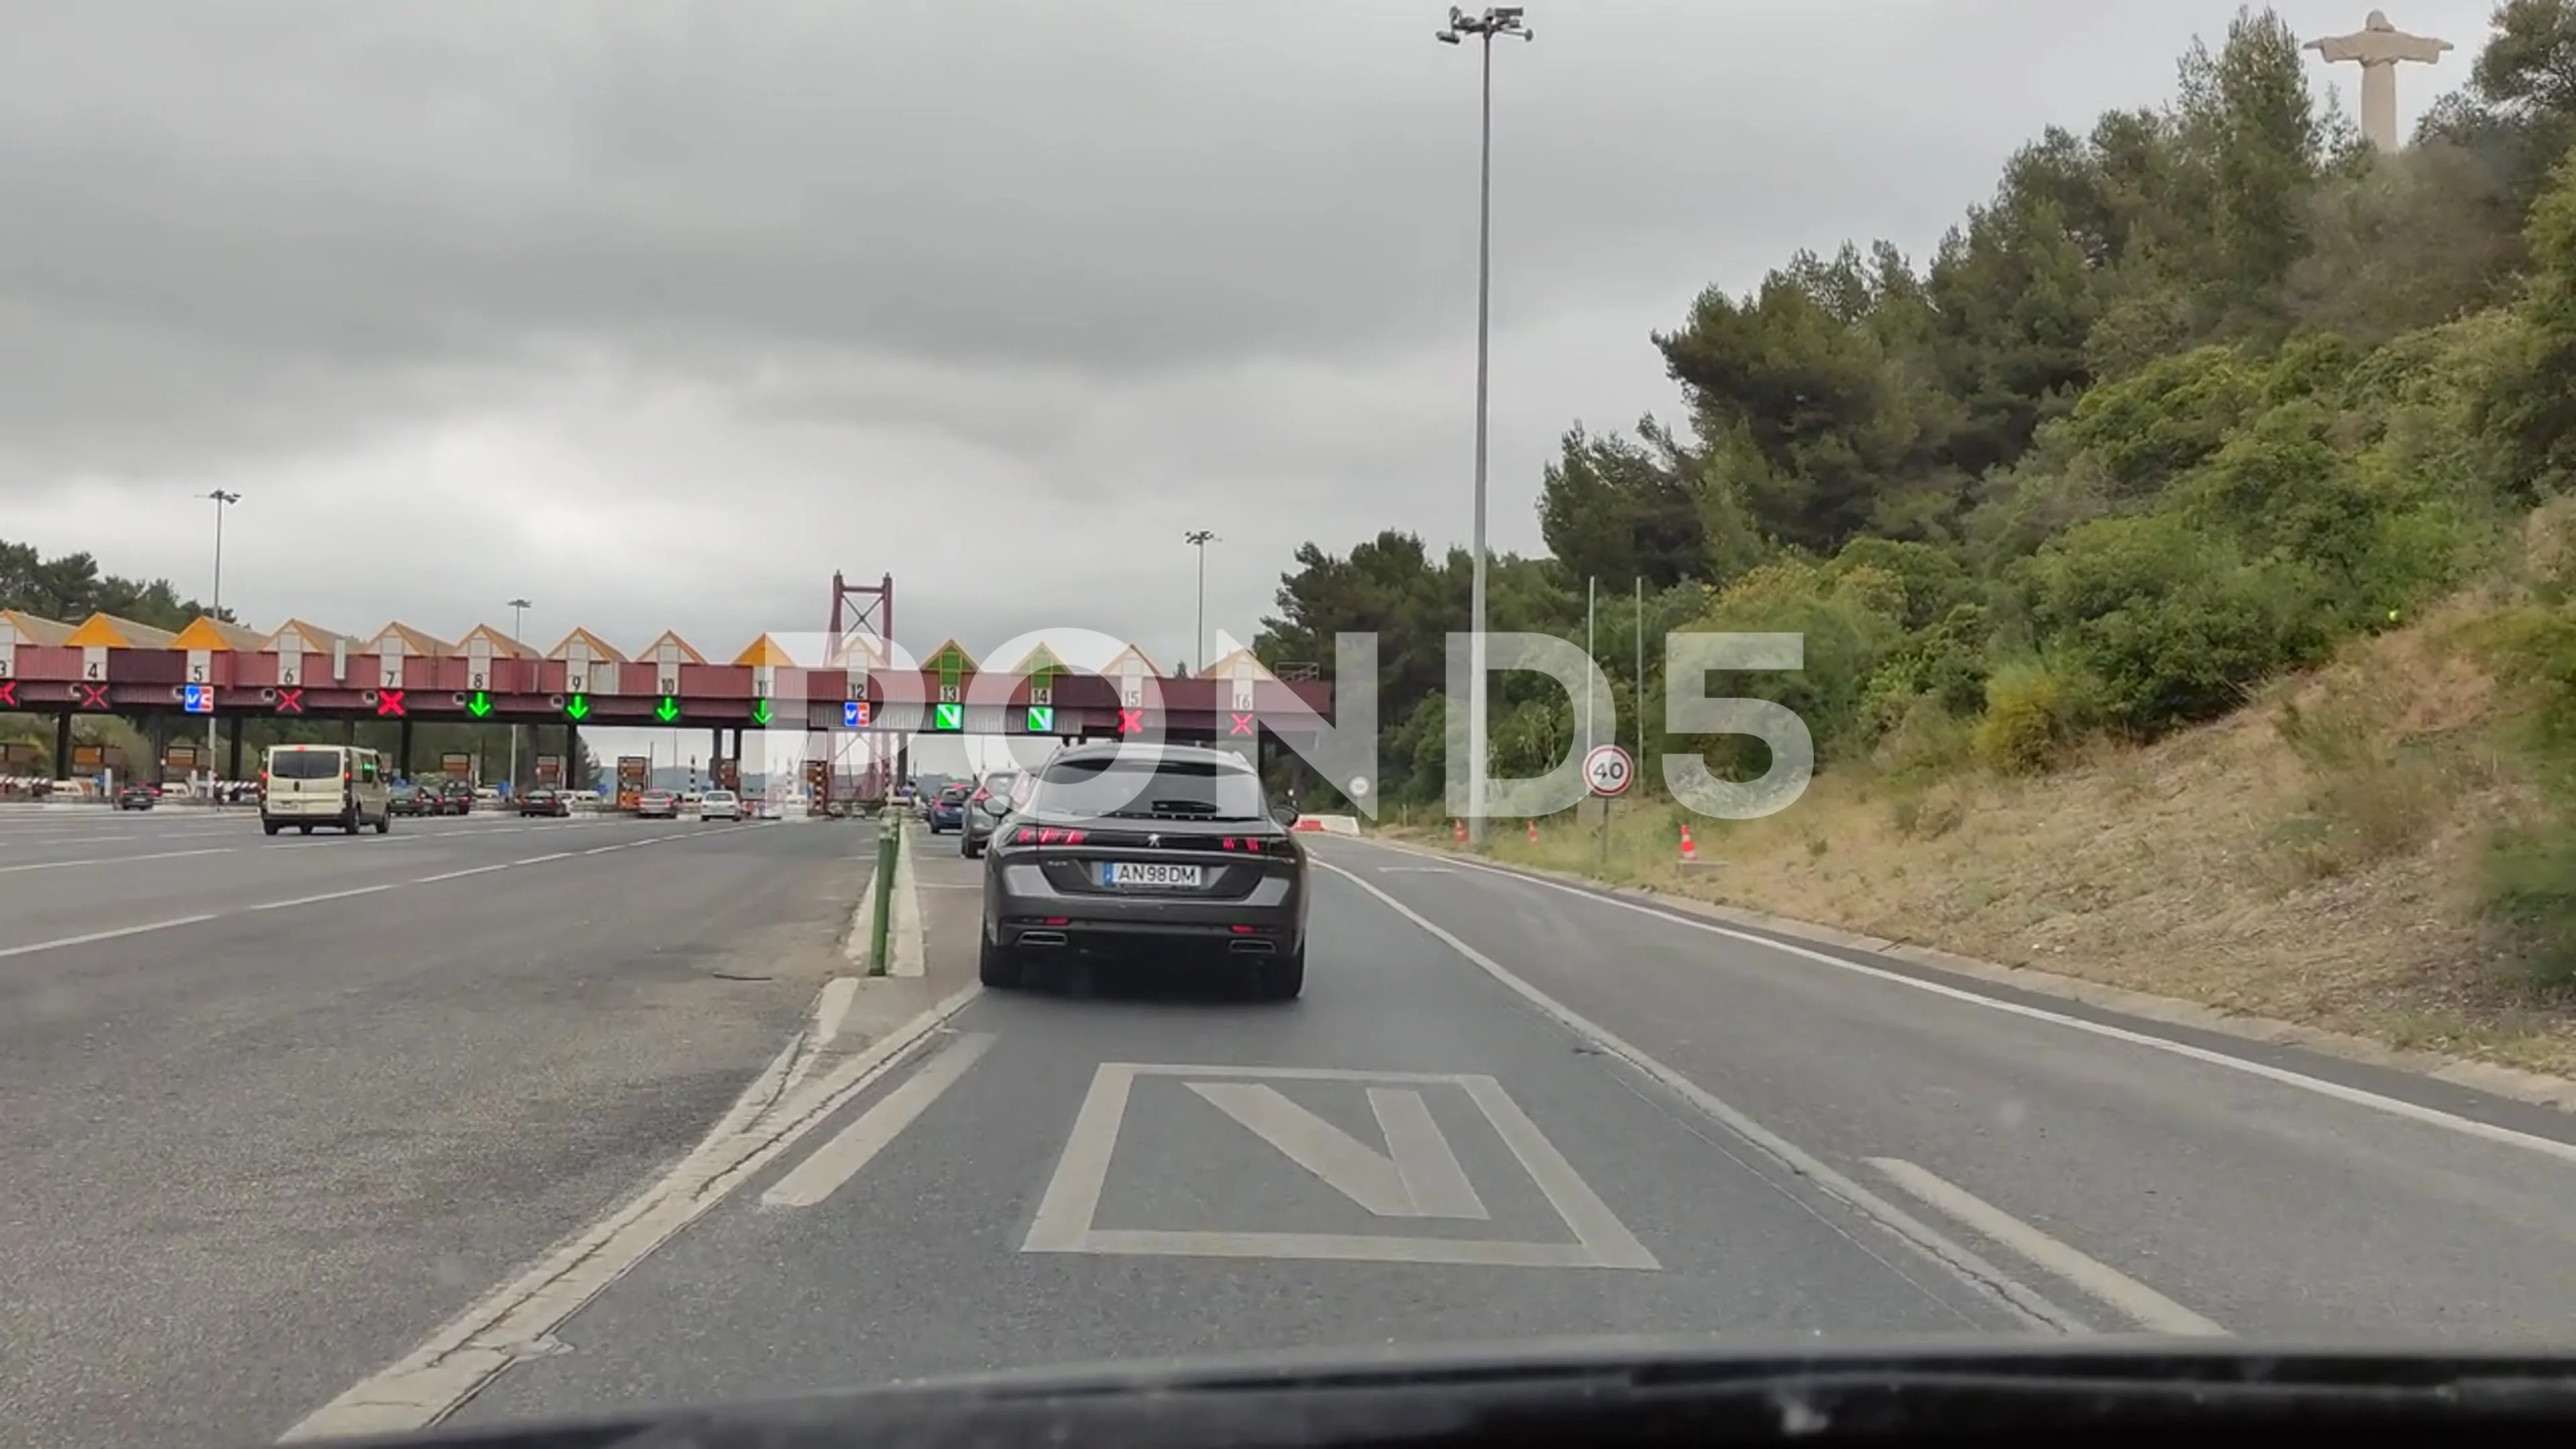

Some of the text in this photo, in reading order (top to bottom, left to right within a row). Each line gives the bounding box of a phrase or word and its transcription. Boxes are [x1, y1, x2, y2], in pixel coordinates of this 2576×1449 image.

[88, 663, 98, 678] 4
[194, 665, 203, 682] 5
[284, 668, 293, 684] 6
[386, 672, 394, 687] 7
[474, 674, 483, 688] 8
[572, 676, 580, 690] 9
[661, 678, 675, 694] 10
[851, 684, 864, 699] 12
[943, 686, 957, 701] 13
[1034, 689, 1048, 703] 14
[1125, 691, 1138, 706] 15
[1236, 694, 1250, 708] 16
[1594, 762, 1623, 780] 40
